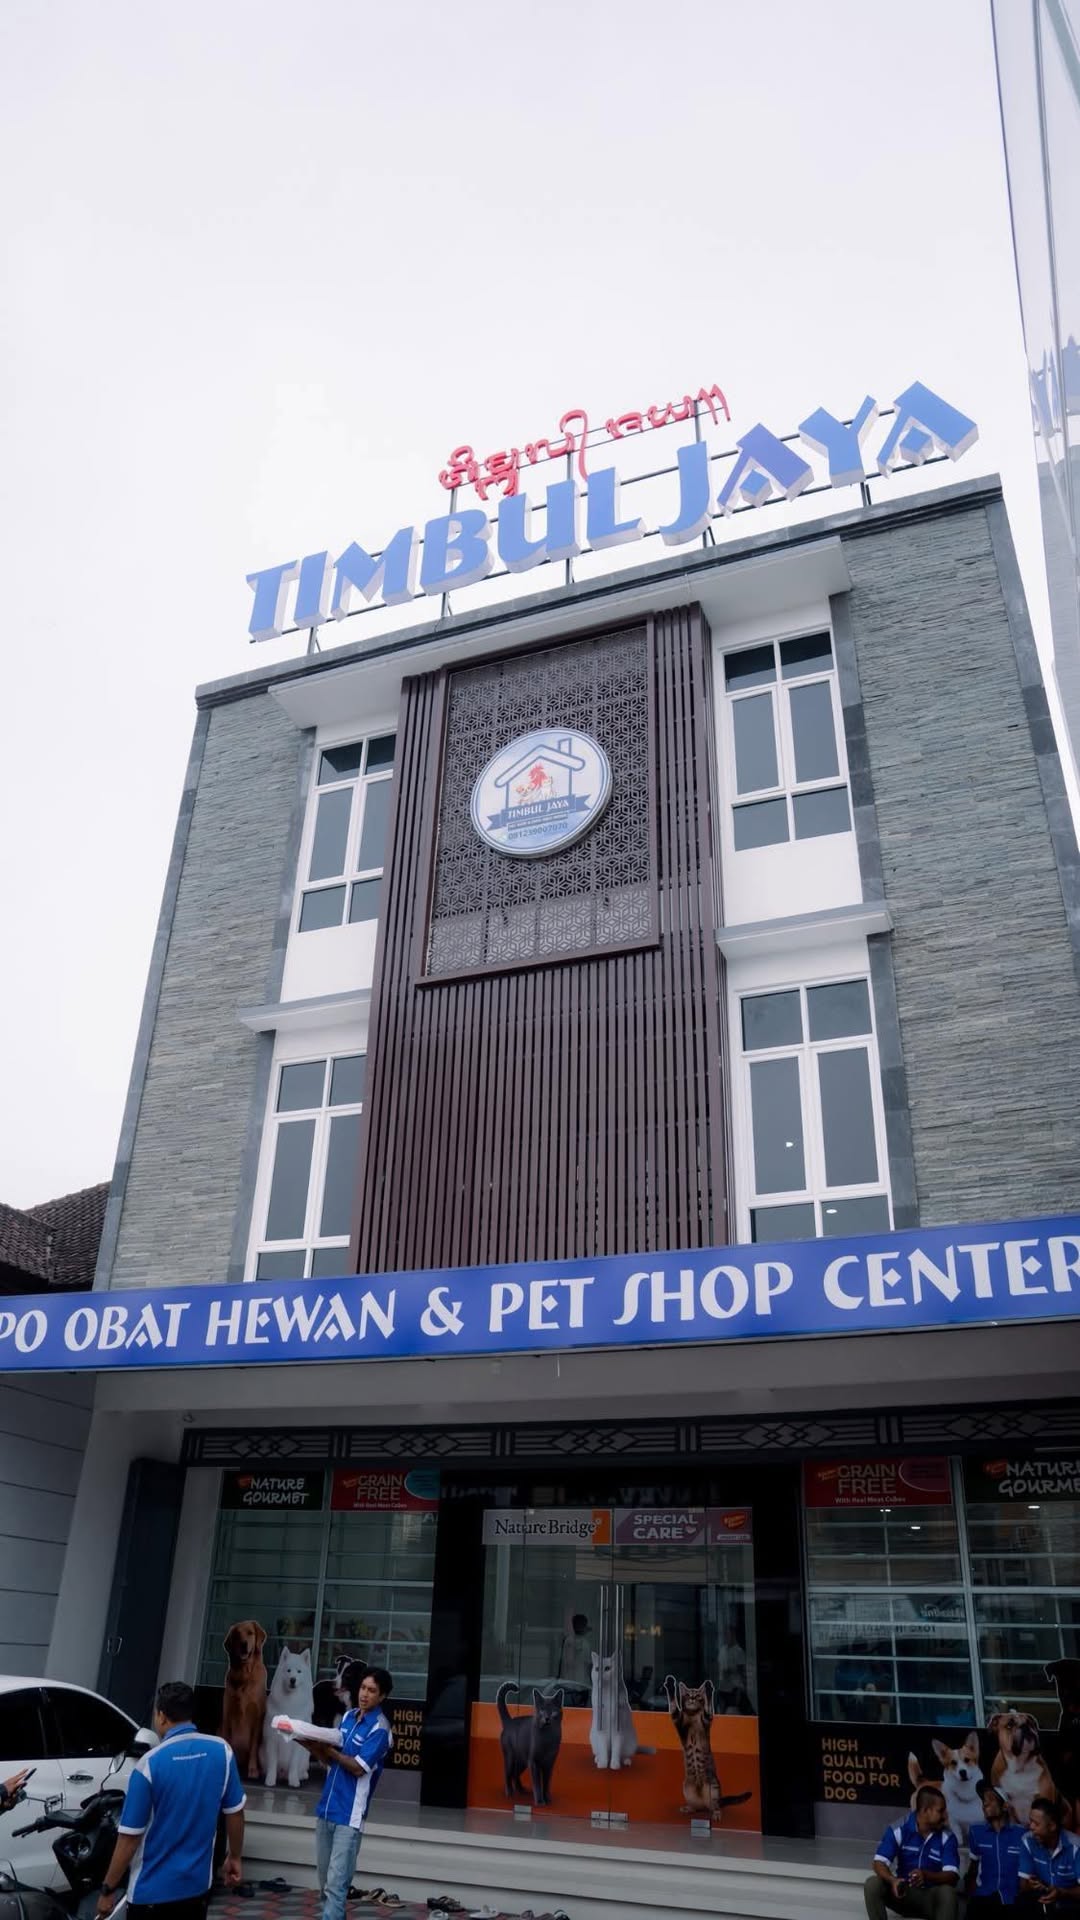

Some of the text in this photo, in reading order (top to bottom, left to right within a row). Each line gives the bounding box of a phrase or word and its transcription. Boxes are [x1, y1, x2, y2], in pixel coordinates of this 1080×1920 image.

[246, 381, 977, 641] TIMBUL JAYA
[508, 800, 569, 818] TIMBUL JAYA
[64, 1302, 191, 1352] OBAT
[205, 1289, 396, 1346] HEWAN
[420, 1286, 465, 1336] &
[489, 1277, 595, 1333] PET
[614, 1261, 794, 1325] SHOP
[823, 1235, 1080, 1310] CENTER
[837, 1463, 896, 1478] GRAIN
[250, 1478, 305, 1490] NATURE
[358, 1474, 403, 1487] GRAIN
[838, 1478, 897, 1495] FREE
[243, 1491, 309, 1505] GOURMET
[357, 1487, 400, 1501] FREE
[633, 1514, 698, 1525] SPECIAL
[633, 1527, 683, 1539] CARE
[394, 1709, 423, 1722] HIGH
[397, 1739, 421, 1751] FOR
[821, 1738, 859, 1752] HIGH
[394, 1753, 420, 1766] DOG
[822, 1754, 886, 1769] QUALITY
[824, 1770, 900, 1787] FOOD FOR
[824, 1786, 858, 1800] DOG
